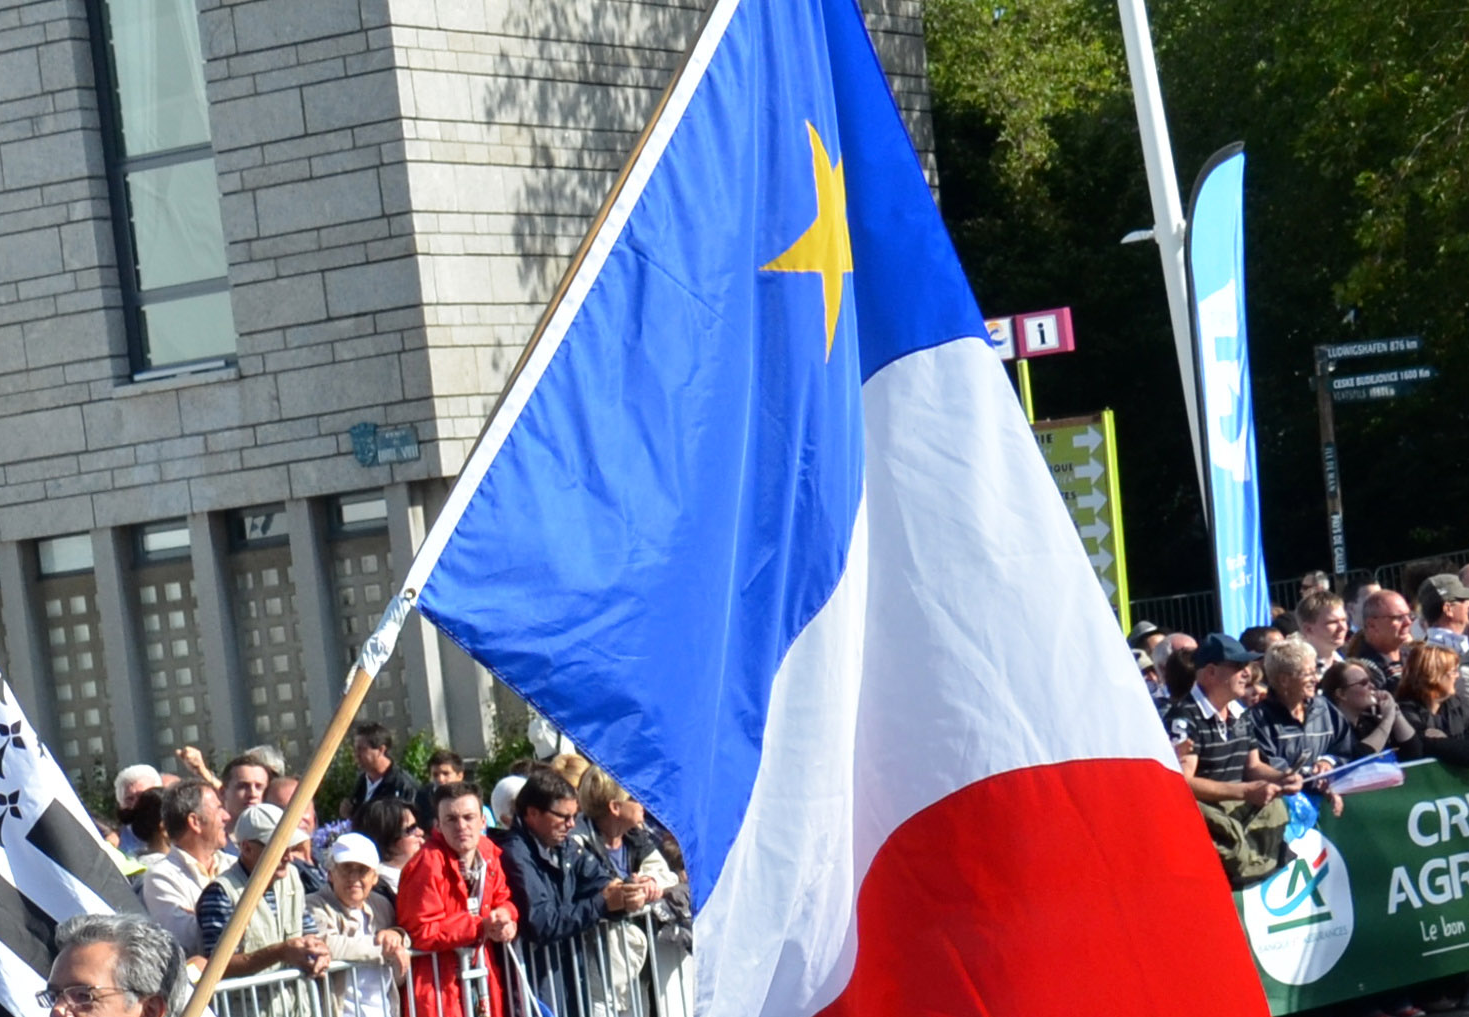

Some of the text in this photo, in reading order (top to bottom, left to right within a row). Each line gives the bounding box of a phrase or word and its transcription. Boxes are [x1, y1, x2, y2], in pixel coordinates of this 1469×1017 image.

[1327, 340, 1418, 358] LUDWIGSHAFEN 876 km
[1331, 514, 1346, 574] PAYS DE GALLES
[1407, 792, 1469, 847] CR
[1420, 915, 1466, 942] Le bon
